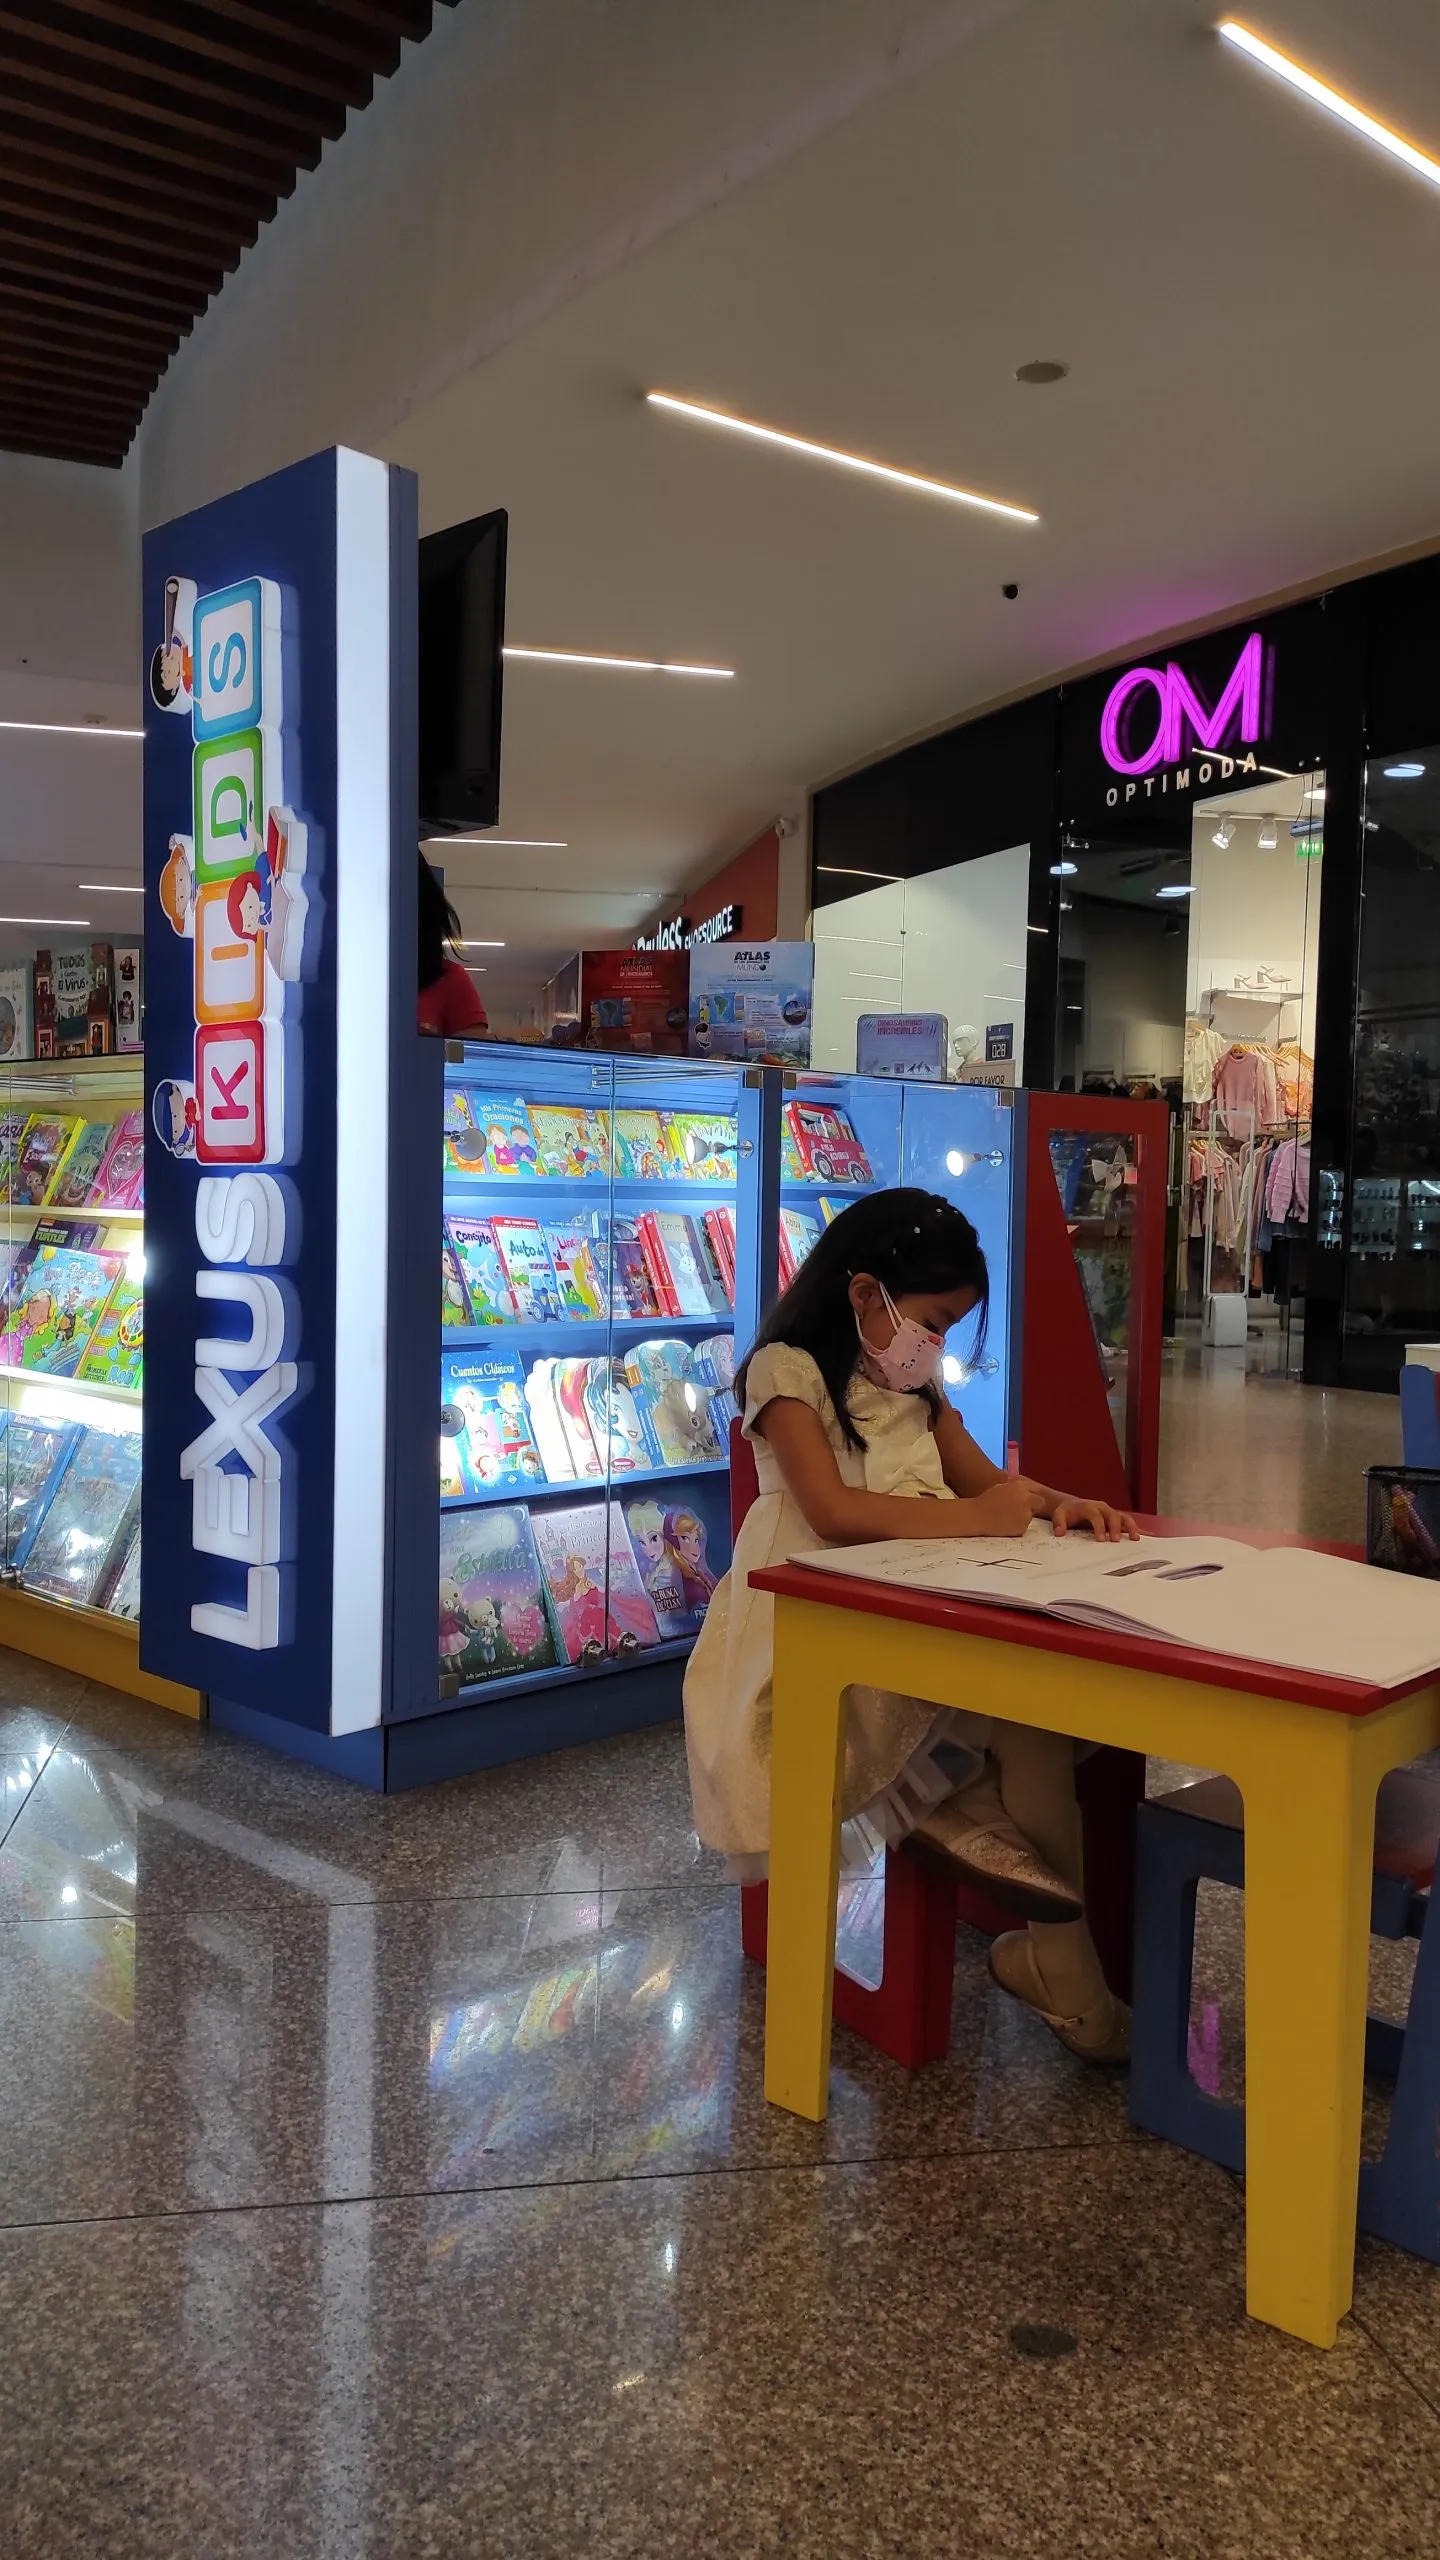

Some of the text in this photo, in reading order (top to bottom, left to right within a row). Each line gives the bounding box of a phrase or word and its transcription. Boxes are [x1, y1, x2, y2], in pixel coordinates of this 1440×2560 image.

[1101, 632, 1263, 775] OM
[1106, 752, 1257, 806] OPTIMODA
[58, 953, 85, 969] TODOS
[984, 1074, 1006, 1085] FAVOR
[482, 1112, 524, 1125] Oraciones
[455, 1230, 492, 1247] Conejito
[509, 1239, 537, 1257] Auto
[450, 1365, 483, 1378] Cuentos
[180, 1173, 292, 1650] LEXUS
